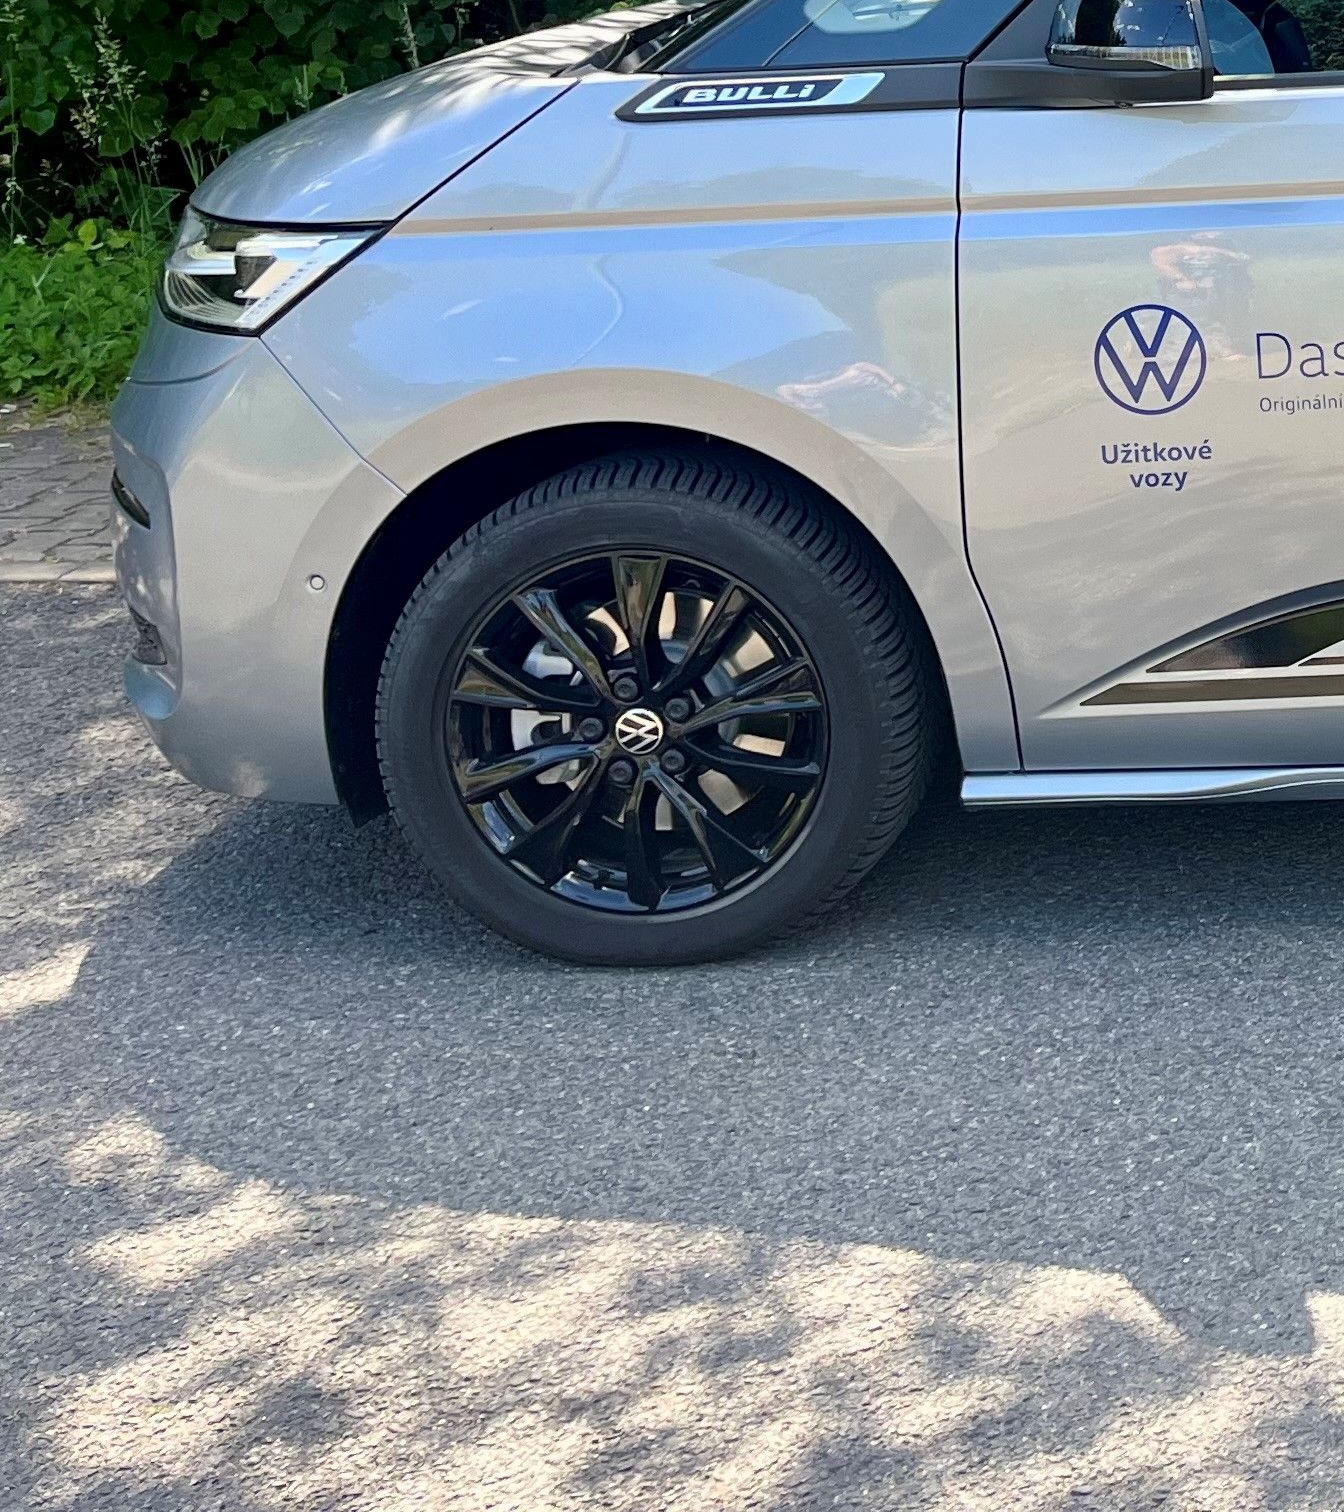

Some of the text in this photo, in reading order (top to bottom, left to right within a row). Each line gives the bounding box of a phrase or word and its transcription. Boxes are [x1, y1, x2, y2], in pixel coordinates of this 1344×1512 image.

[1259, 392, 1343, 415] Originální
[1101, 438, 1213, 465] Užitkové
[1130, 467, 1188, 491] vozy
